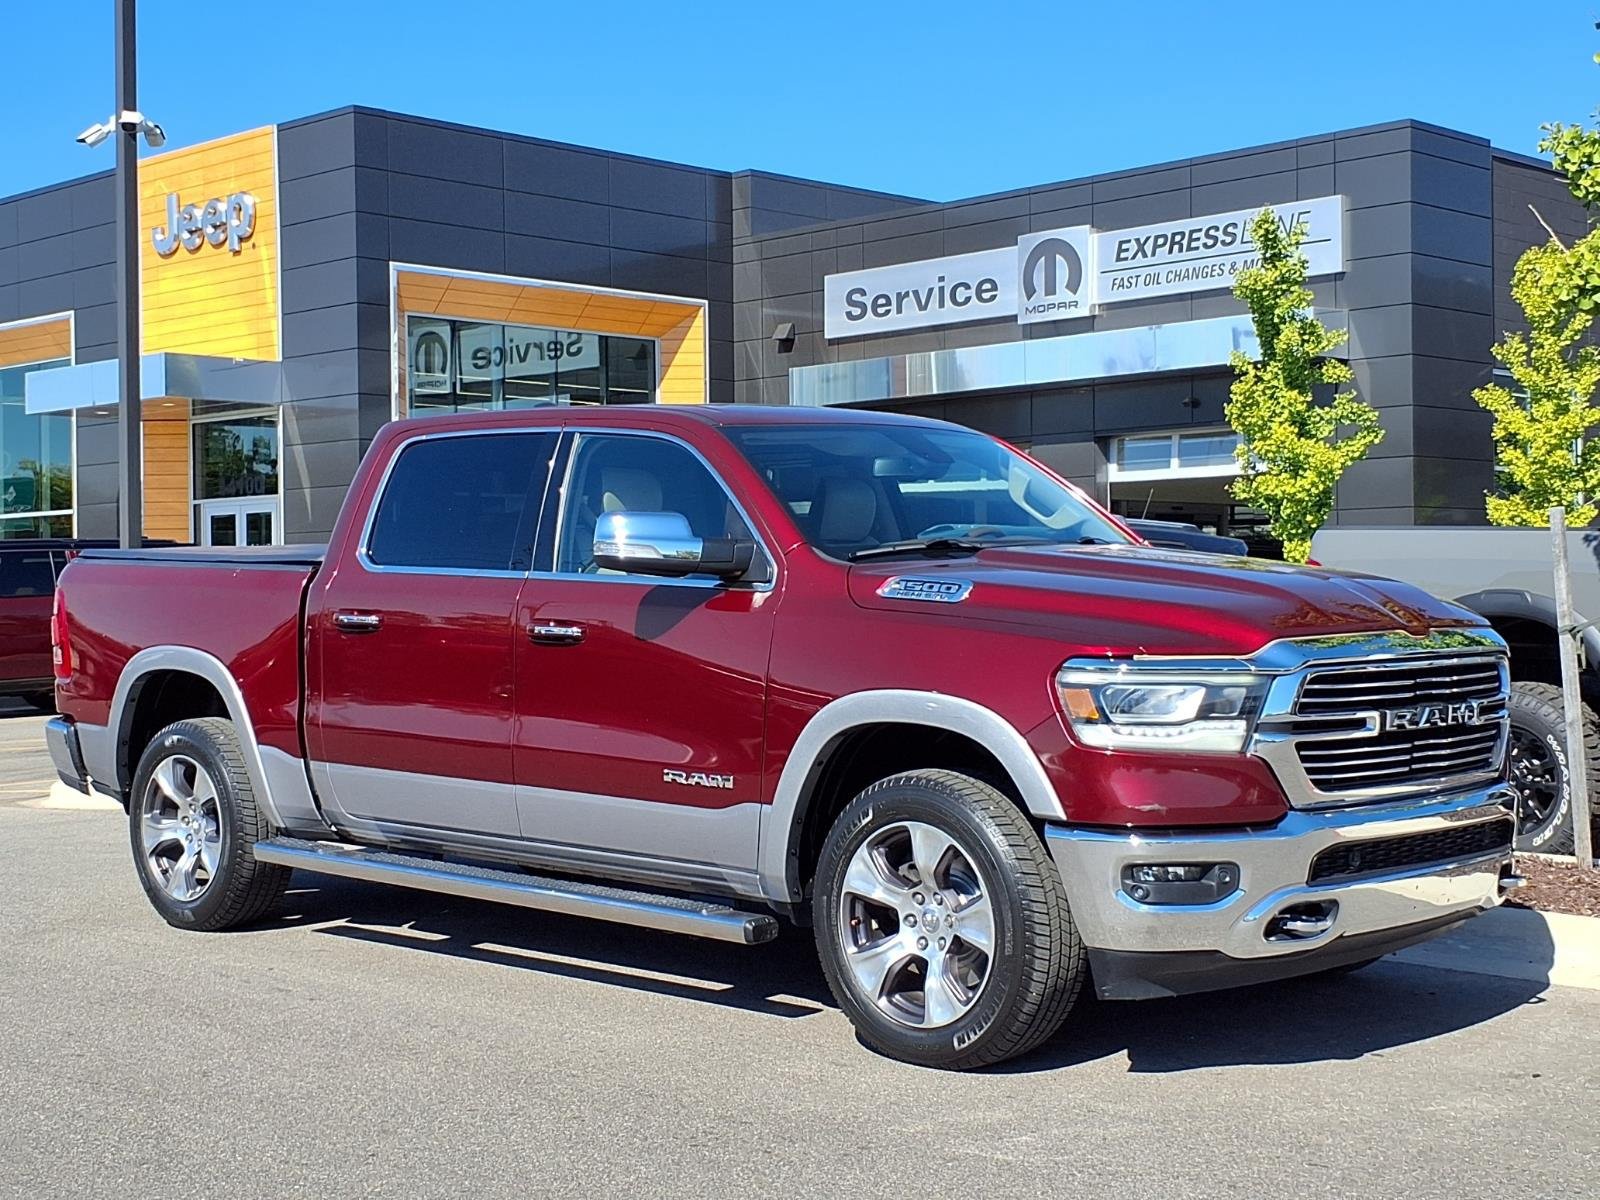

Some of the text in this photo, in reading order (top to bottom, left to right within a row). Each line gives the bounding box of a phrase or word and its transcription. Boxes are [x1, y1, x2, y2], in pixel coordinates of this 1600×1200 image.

[152, 191, 256, 257] Jeep
[1115, 210, 1311, 262] EXPRESSLNE
[1111, 275, 1141, 291] FAST
[1143, 271, 1162, 287] OIL
[1165, 261, 1225, 284] CHANGES
[1228, 260, 1237, 275] &
[844, 275, 999, 322] Service
[1025, 300, 1079, 315] MOPAR
[891, 579, 960, 594] 1500
[1385, 701, 1487, 731] RAM
[663, 768, 734, 790] RAM
